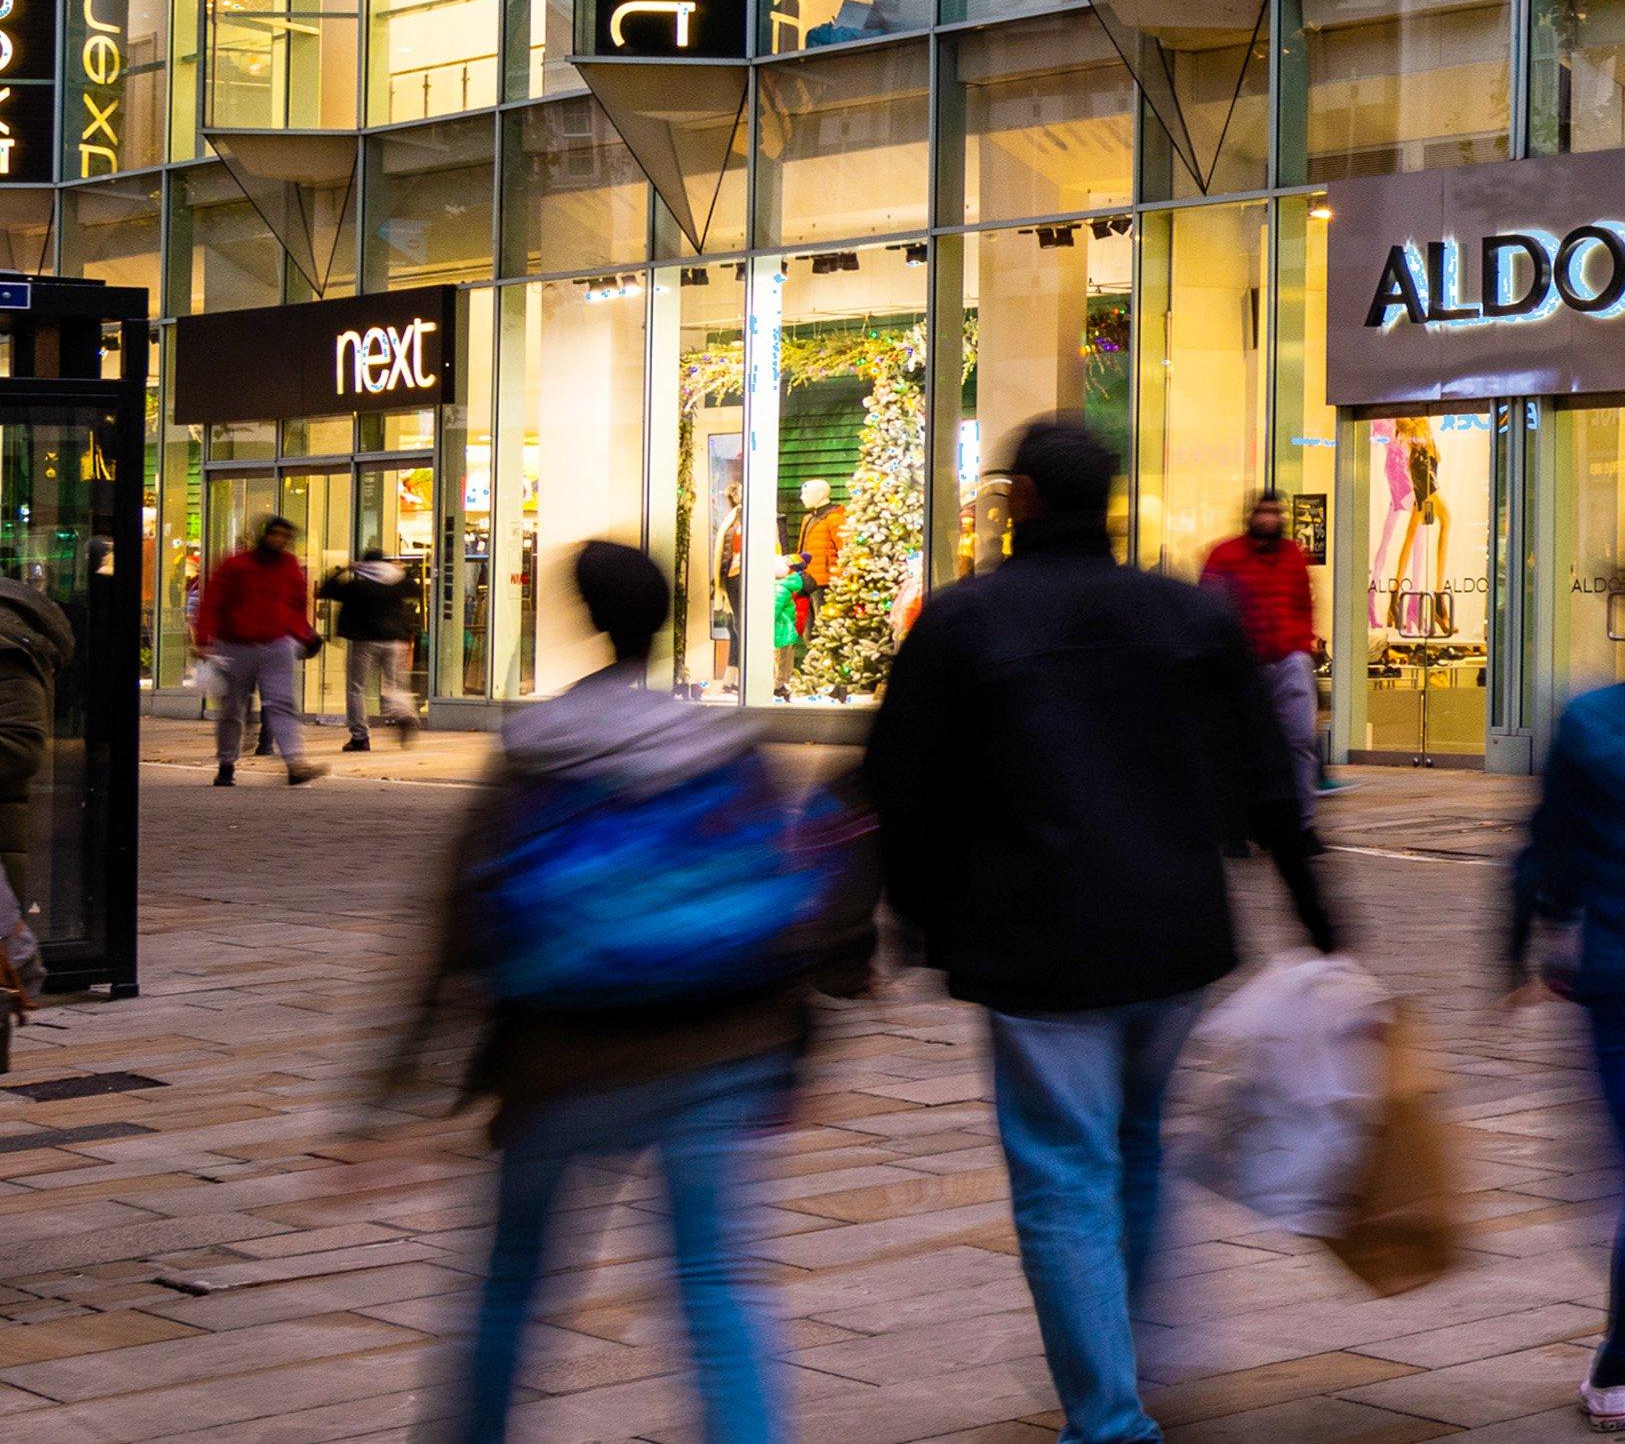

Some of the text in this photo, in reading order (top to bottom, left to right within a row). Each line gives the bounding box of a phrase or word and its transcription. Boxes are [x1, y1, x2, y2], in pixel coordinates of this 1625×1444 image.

[336, 317, 437, 395] next
[1368, 577, 1413, 593] ALDO
[1443, 577, 1489, 593] ALDO
